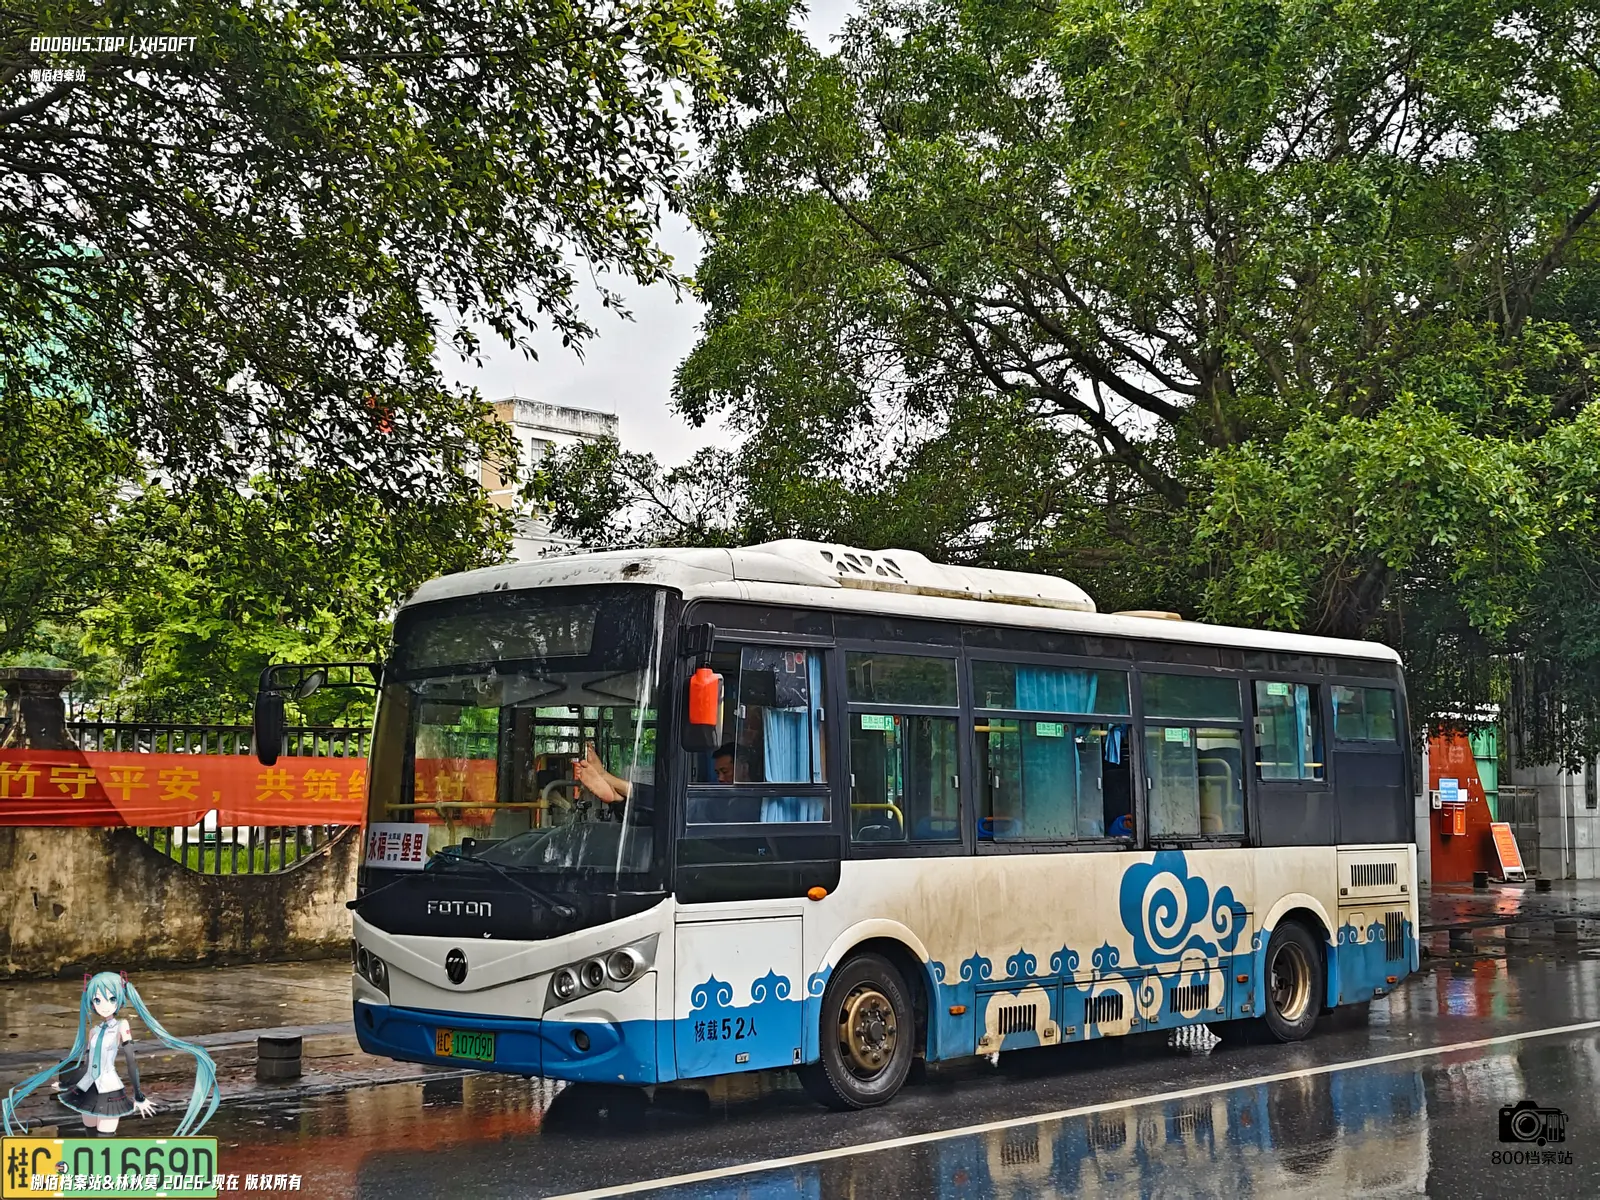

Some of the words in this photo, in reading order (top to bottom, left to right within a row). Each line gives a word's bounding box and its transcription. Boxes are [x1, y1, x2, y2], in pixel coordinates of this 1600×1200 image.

[368, 832, 388, 860] 永福
[400, 833, 423, 861] 堡里
[427, 900, 492, 917] FOTON
[694, 1017, 758, 1042] 核载52人
